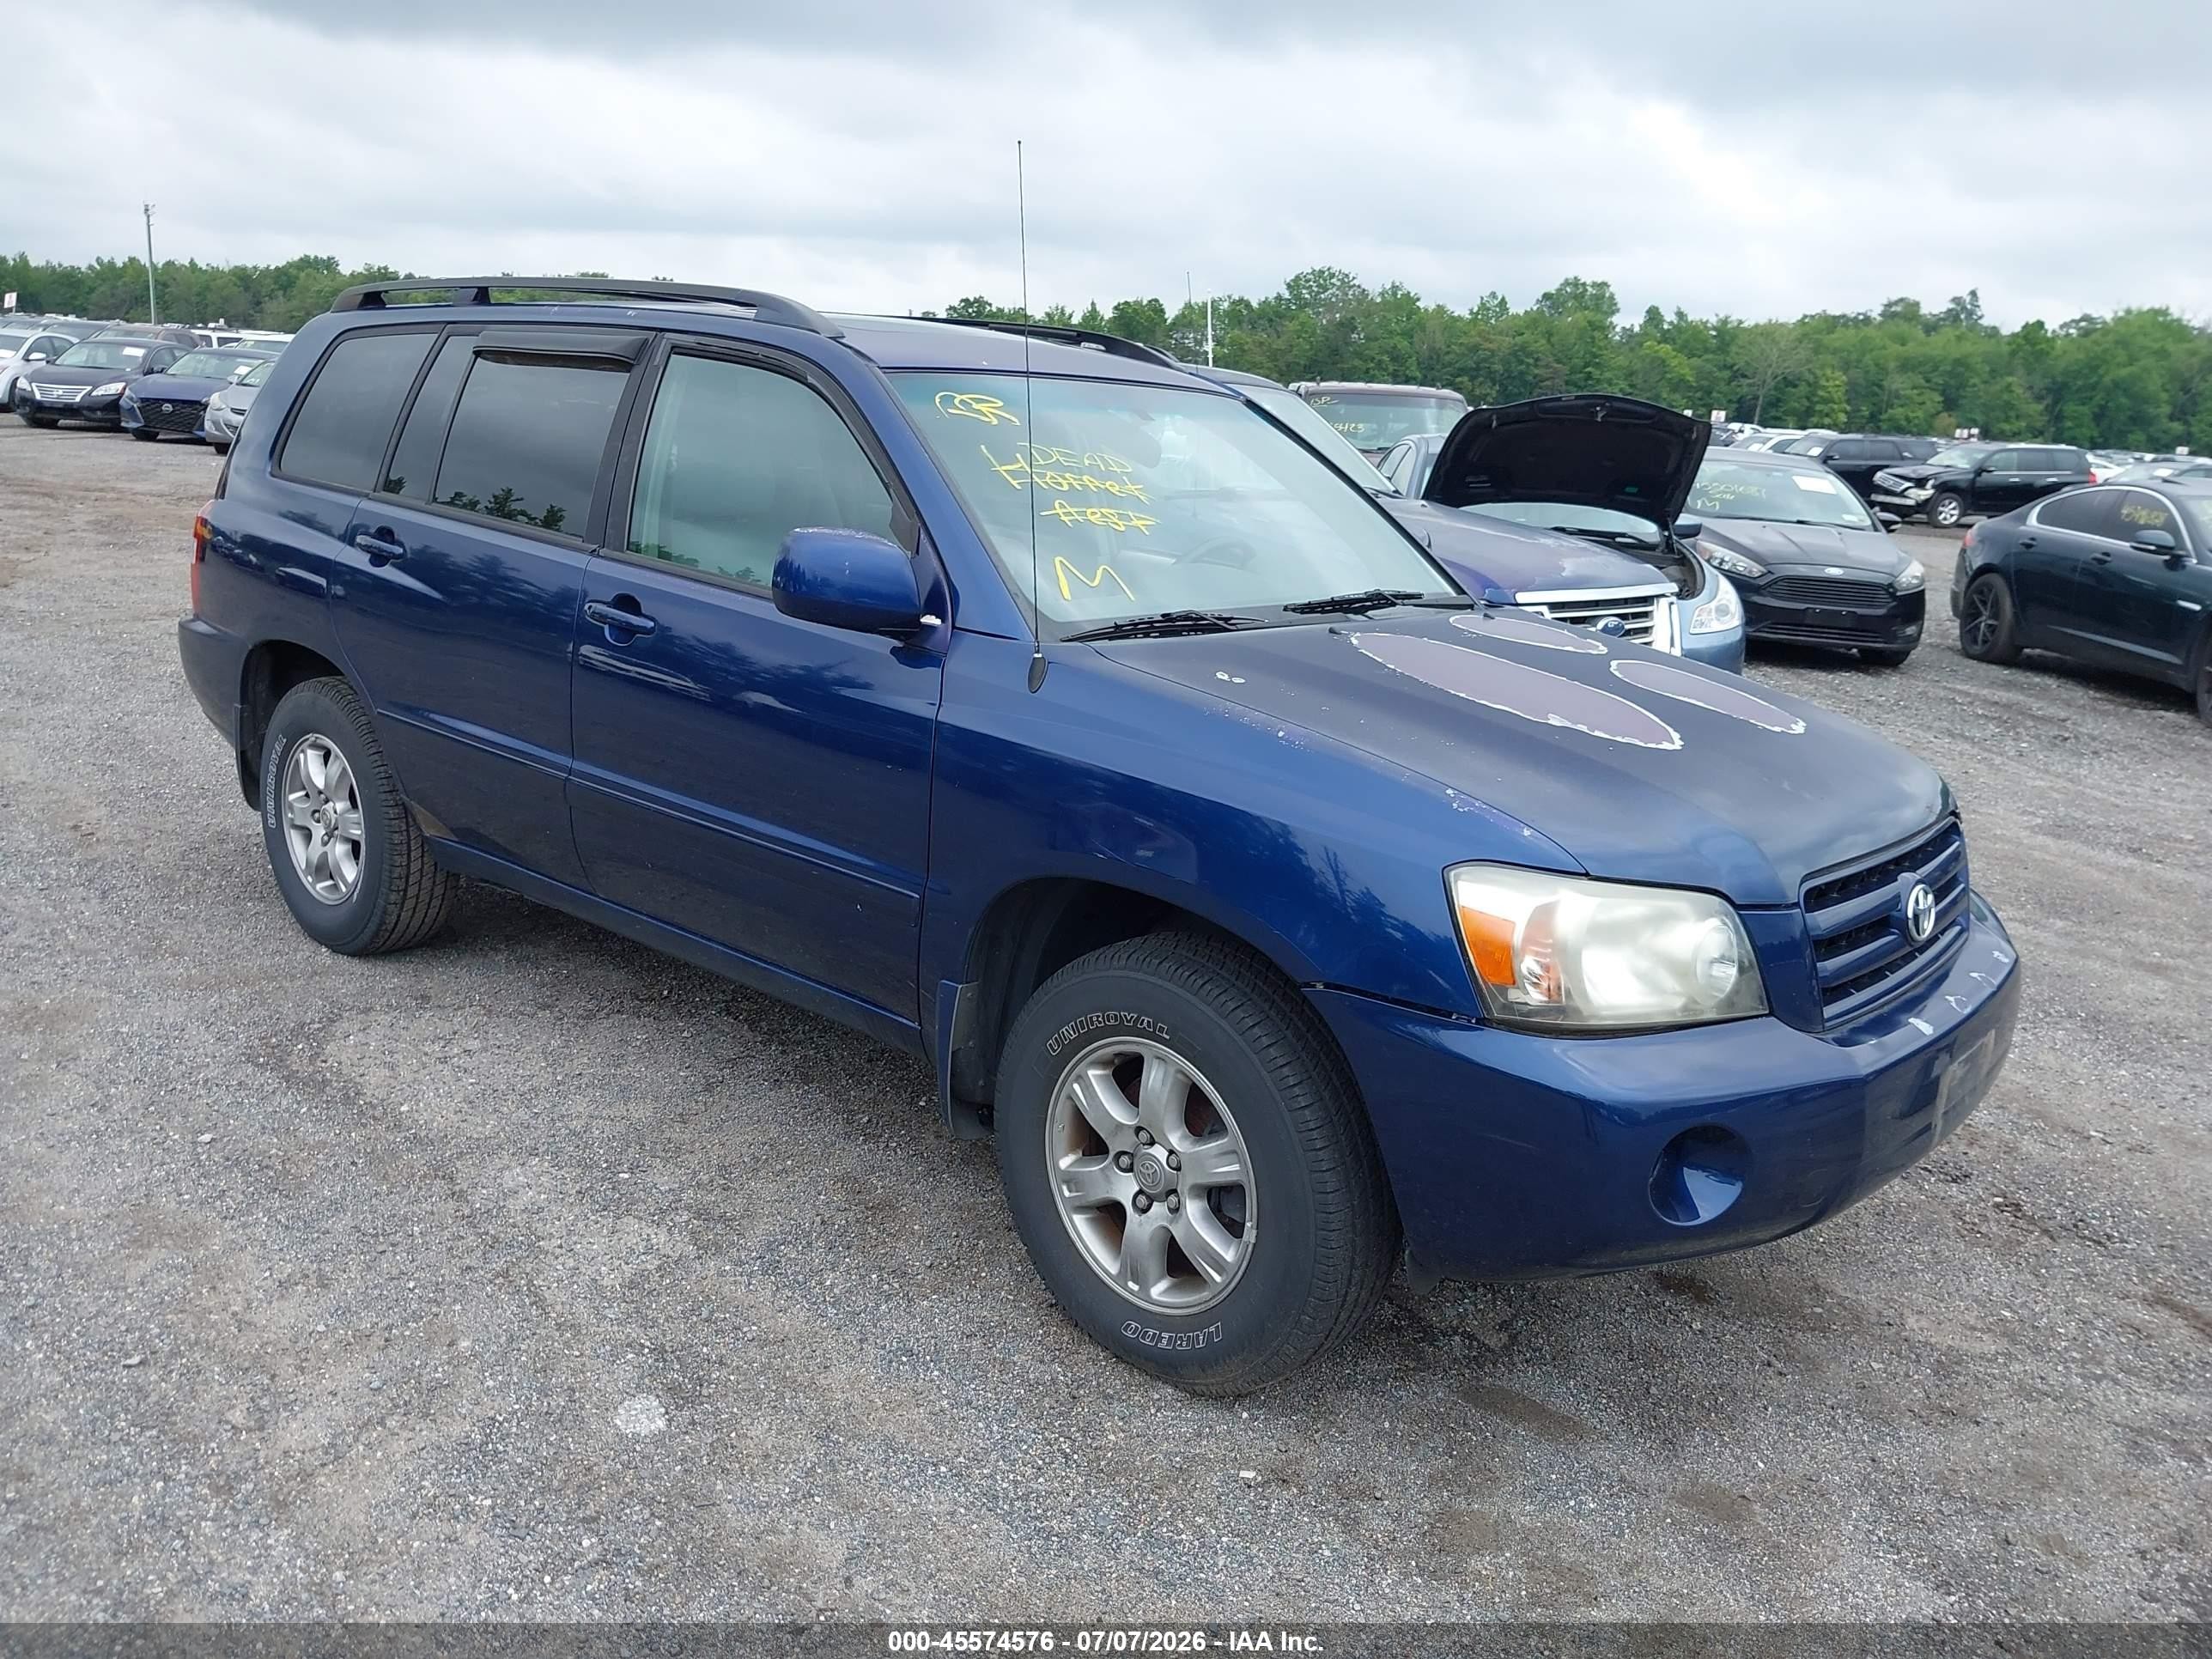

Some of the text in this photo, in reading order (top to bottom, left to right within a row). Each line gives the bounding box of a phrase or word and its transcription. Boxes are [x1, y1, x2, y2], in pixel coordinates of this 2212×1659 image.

[1017, 442, 1133, 473] DEAD
[1054, 556, 1135, 601] M
[266, 734, 287, 829] UNIROYAL
[1046, 1012, 1170, 1056] UNIROYAL
[1121, 1321, 1223, 1350] LAREDO
